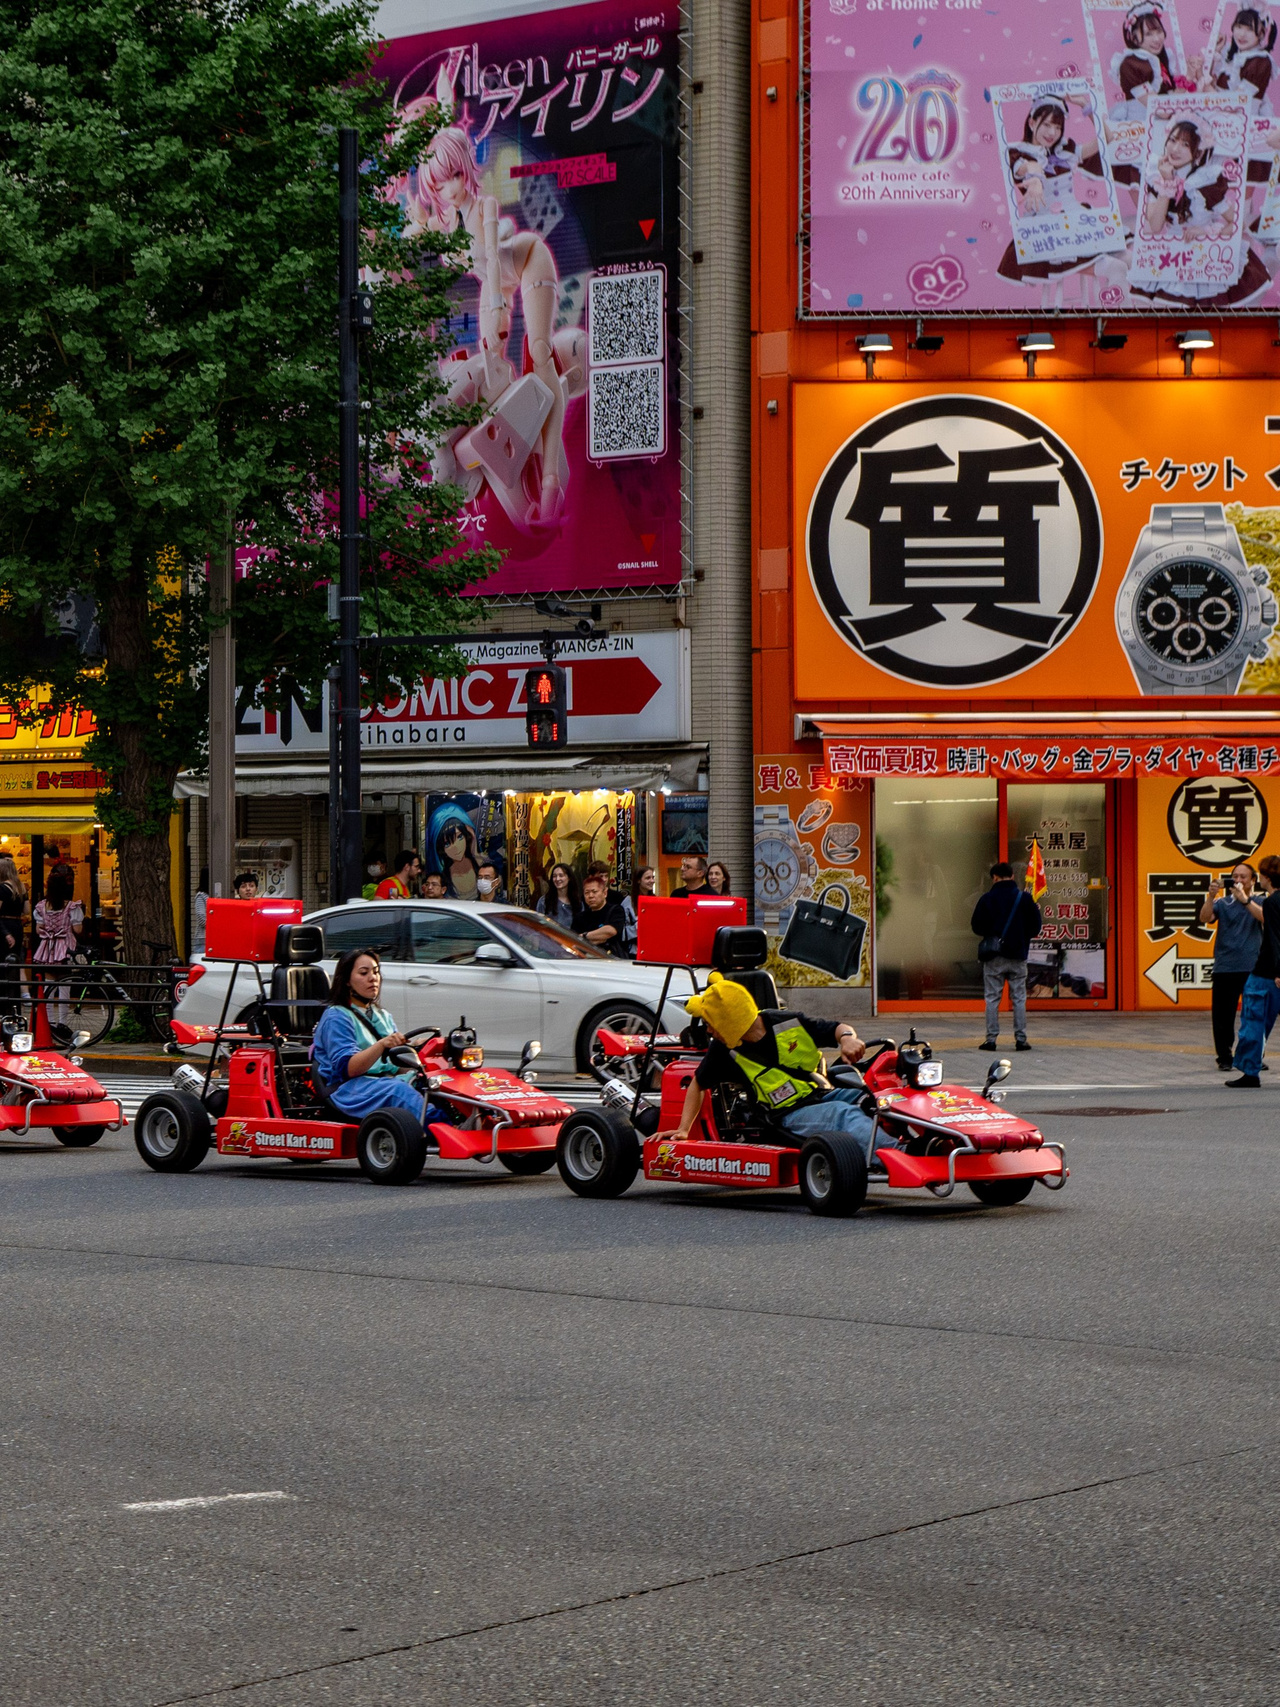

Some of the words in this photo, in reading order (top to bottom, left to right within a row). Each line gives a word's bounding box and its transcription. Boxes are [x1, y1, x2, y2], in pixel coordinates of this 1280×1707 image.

[566, 37, 660, 70] バニーガール
[393, 42, 551, 108] Aileen
[473, 67, 665, 146] アイリン
[852, 76, 961, 168] 20
[577, 164, 616, 184] SCALE
[922, 170, 951, 182] cafe
[841, 186, 876, 201] 20th
[880, 185, 971, 203] Anniversary
[1158, 249, 1194, 271] メイド
[1120, 456, 1248, 493] チケット
[640, 560, 659, 569] SHELL
[828, 745, 939, 774] 高価買取
[617, 808, 626, 880] イラストレーター
[1025, 832, 1088, 852] 大黒屋
[1057, 904, 1089, 919] 買取
[1036, 924, 1089, 940] 定入口
[255, 1131, 286, 1147] Street
[684, 1154, 717, 1172] Street
